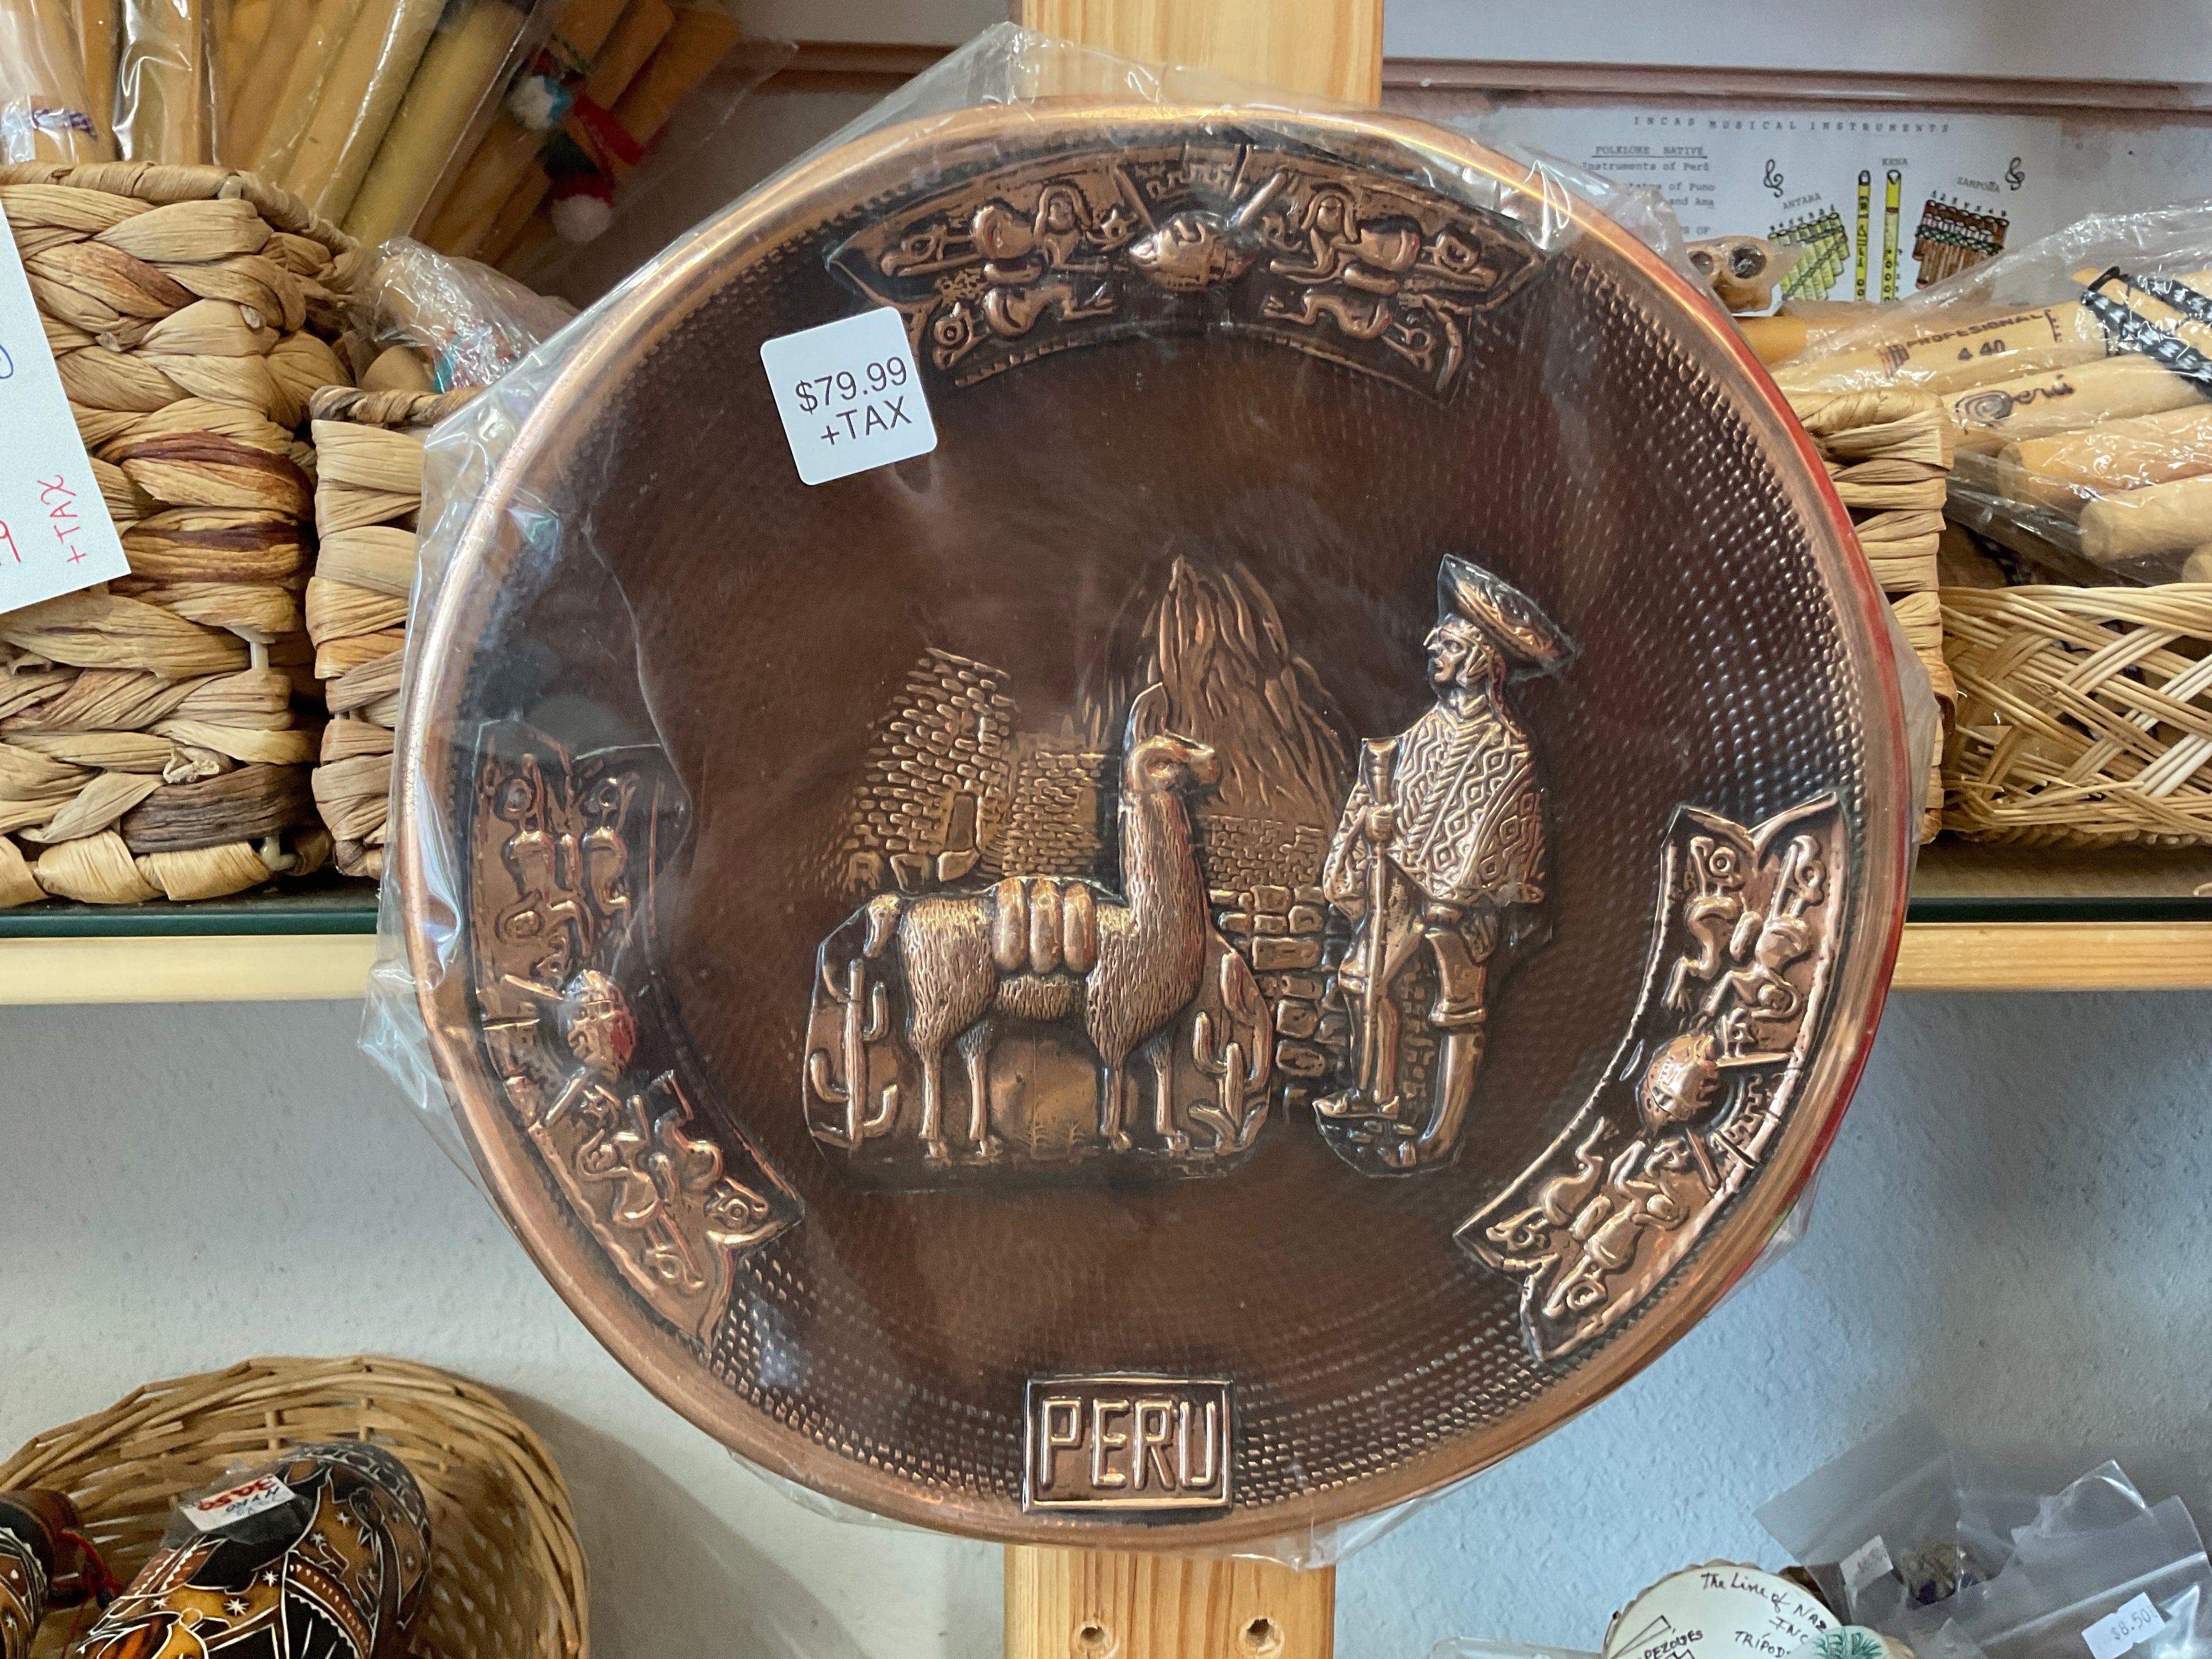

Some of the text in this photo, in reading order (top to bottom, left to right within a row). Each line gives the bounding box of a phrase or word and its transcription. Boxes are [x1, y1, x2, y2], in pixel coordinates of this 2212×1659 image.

[1634, 116, 1949, 133] INCAS MUSICAL INSTRUMENTS
[1662, 162, 1676, 171] of
[1669, 181, 1681, 191] of
[1783, 192, 1821, 209] ANTARA
[795, 356, 907, 415] $79.99
[820, 395, 912, 446] +TAX
[1040, 1396, 1218, 1491] PERU
[1700, 1572, 1726, 1590] The
